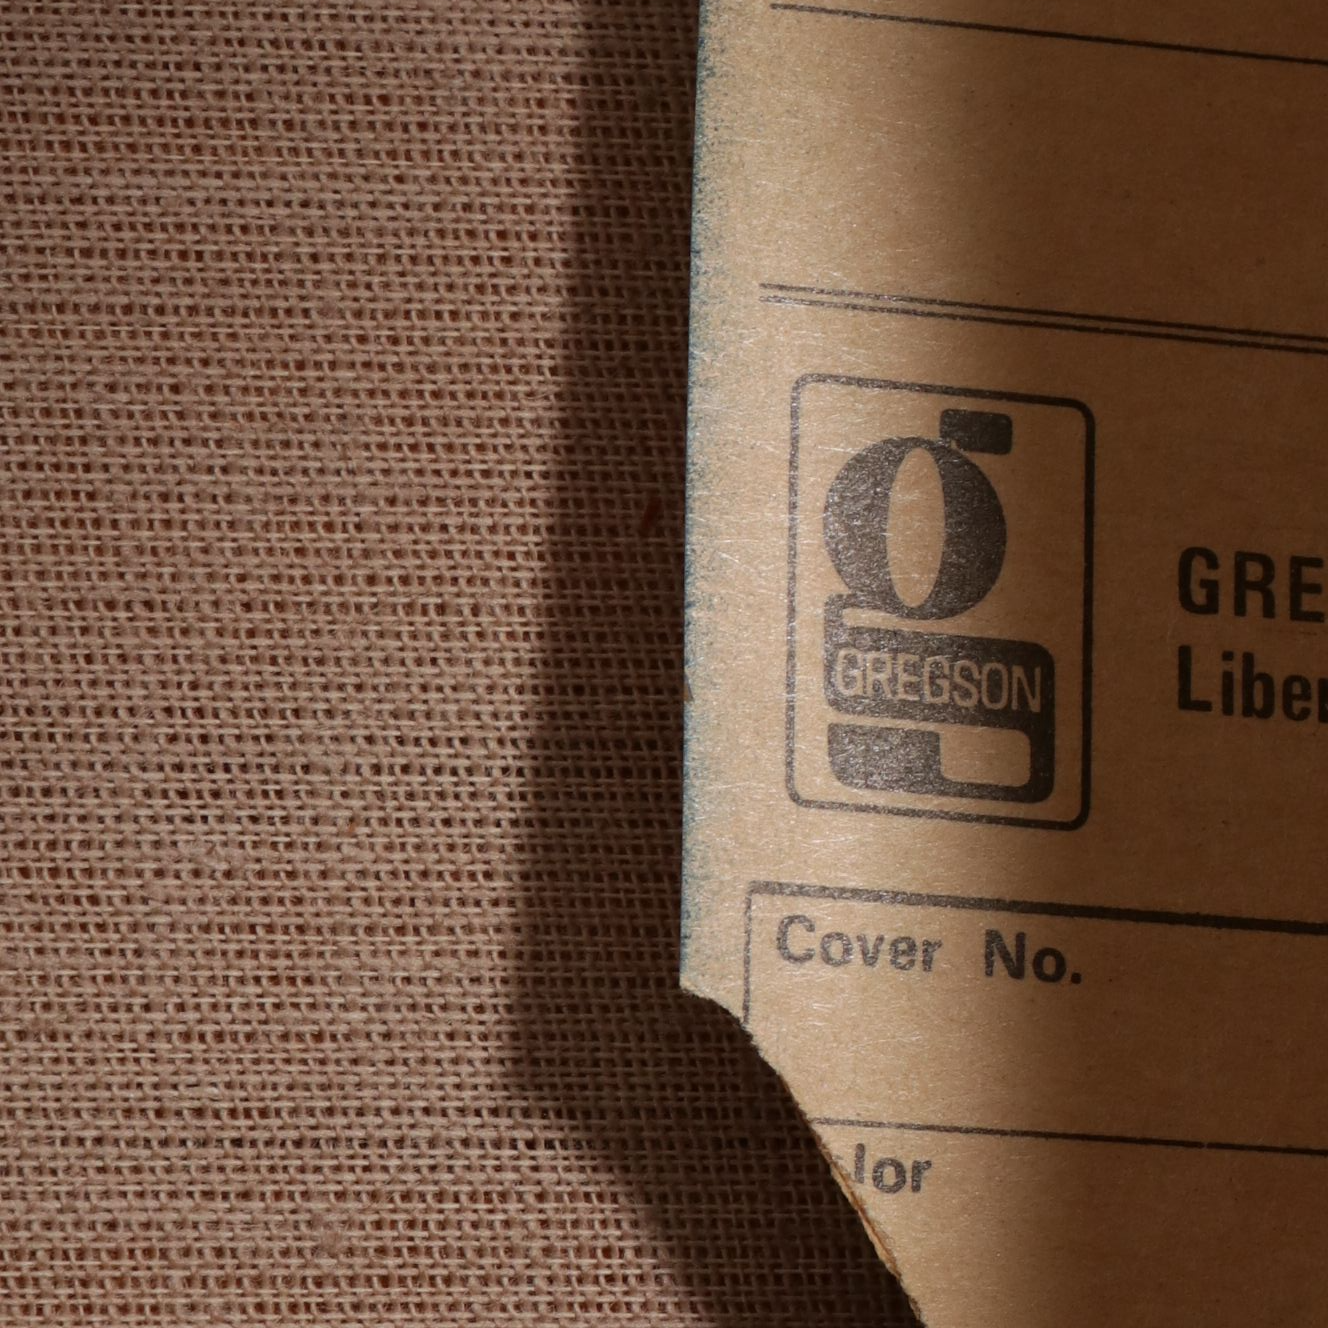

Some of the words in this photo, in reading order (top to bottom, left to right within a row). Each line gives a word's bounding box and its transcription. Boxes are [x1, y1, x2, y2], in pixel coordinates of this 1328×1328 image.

[835, 647, 1043, 713] GREGSON
[776, 914, 942, 973] Cover
[983, 929, 1083, 984] No.
[838, 1143, 932, 1194] lor
